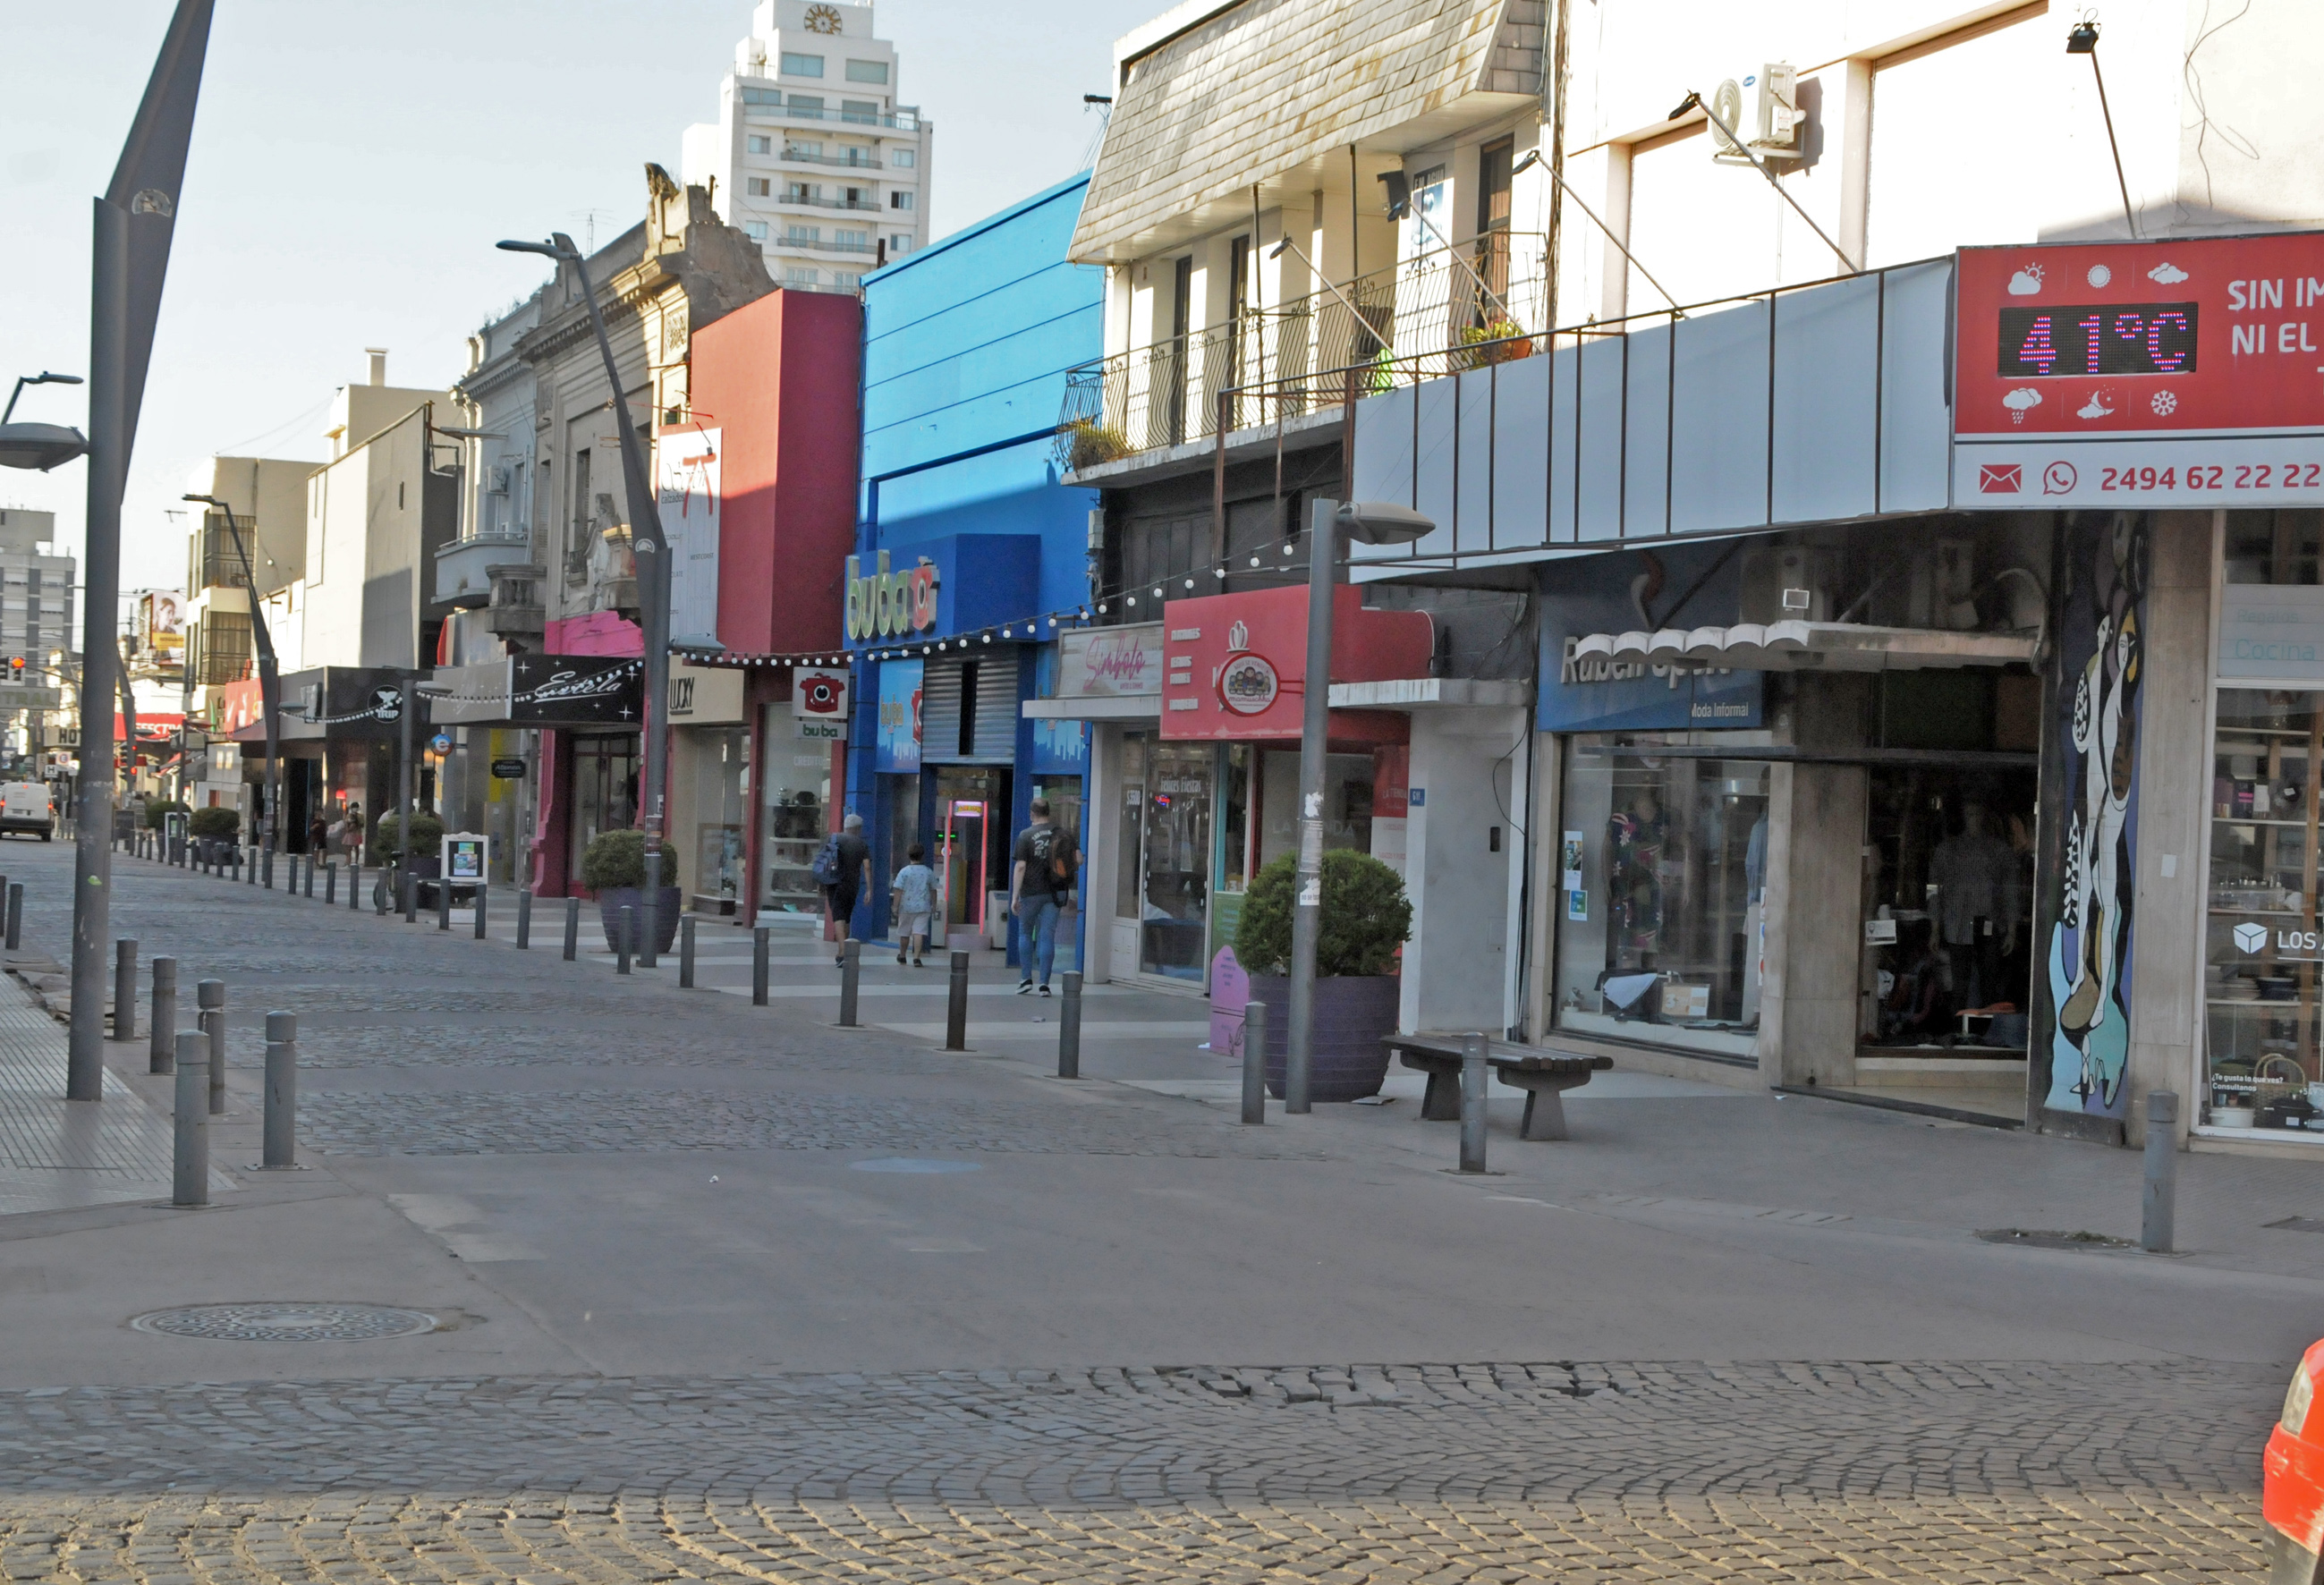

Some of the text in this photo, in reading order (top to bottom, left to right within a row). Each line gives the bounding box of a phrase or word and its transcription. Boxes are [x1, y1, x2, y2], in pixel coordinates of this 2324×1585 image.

[2227, 278, 2283, 310] SIN
[2231, 322, 2317, 355] NI EL
[2101, 463, 2321, 491] 2494 62 22 22
[846, 548, 910, 640] buba
[2237, 608, 2299, 625] Regalos
[2235, 639, 2316, 661] Cocina
[535, 671, 623, 698] Estela
[669, 676, 695, 710] LUCKY
[1713, 701, 1749, 717] Informal
[2277, 930, 2316, 950] LOS
[2212, 1082, 2257, 1092] Consultanos
[2224, 1074, 2243, 1082] gusta
